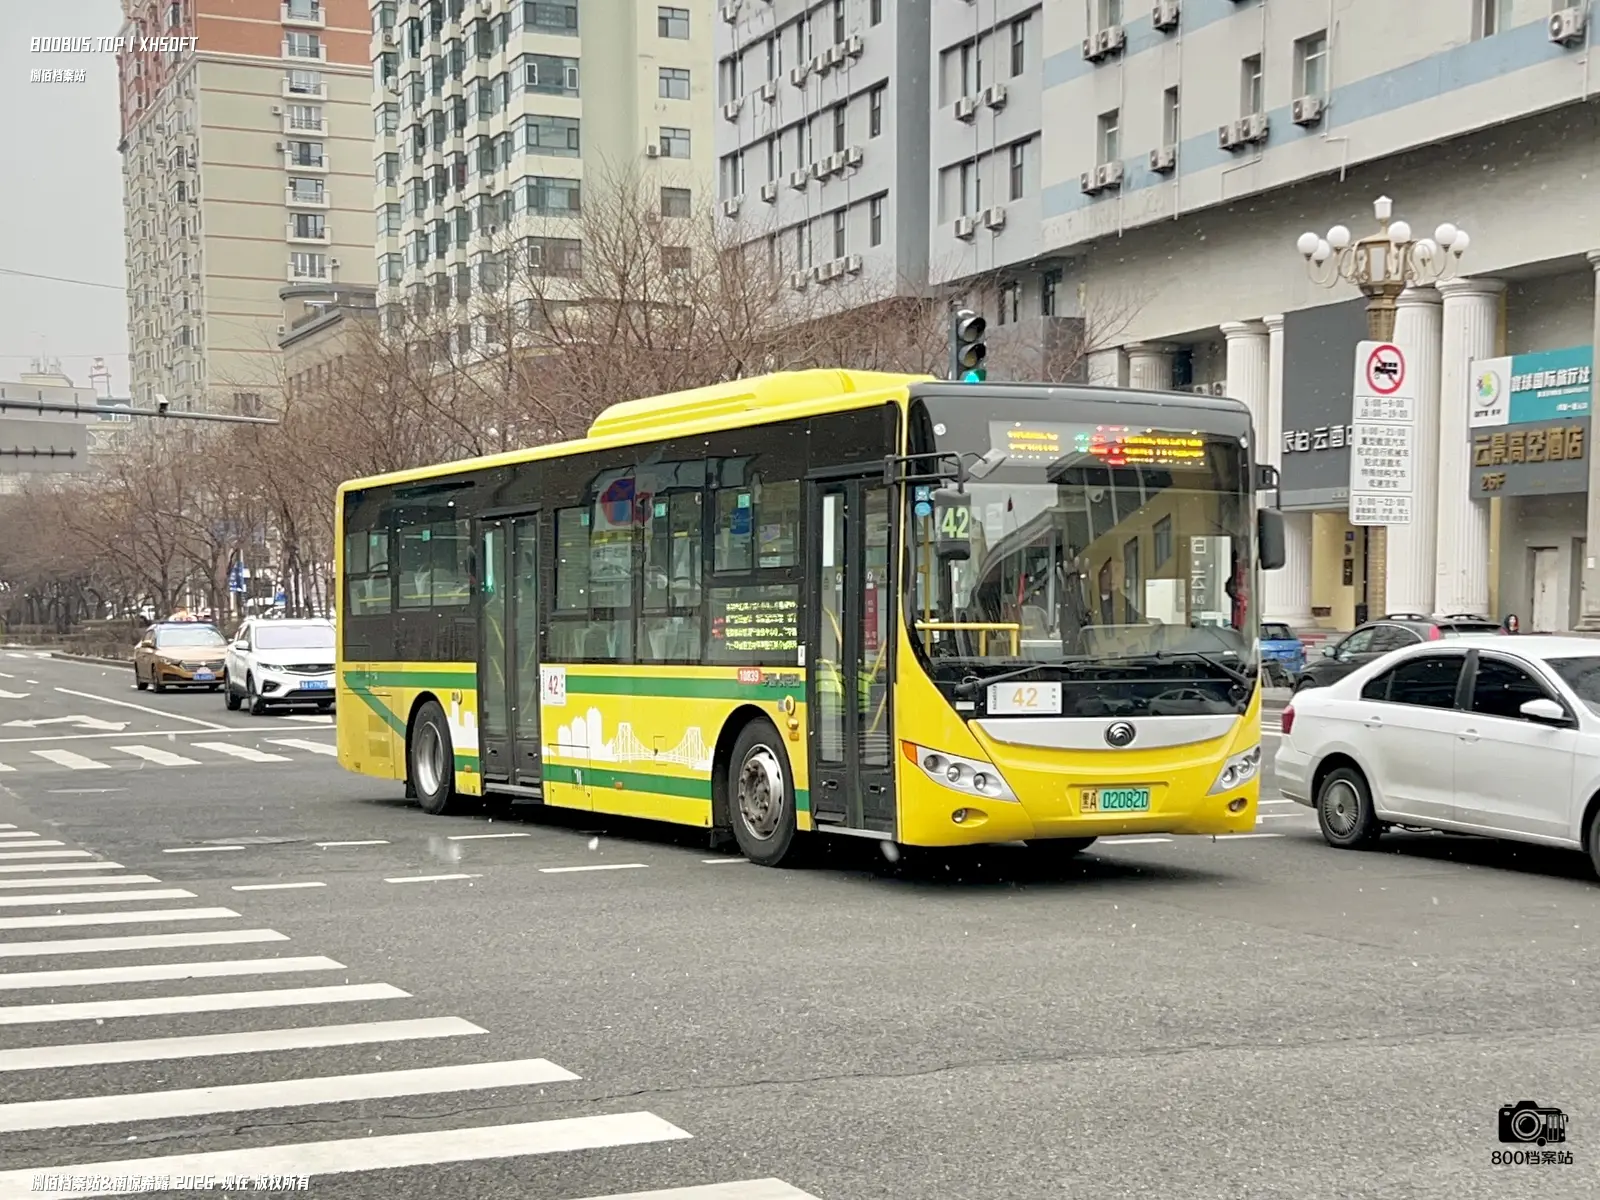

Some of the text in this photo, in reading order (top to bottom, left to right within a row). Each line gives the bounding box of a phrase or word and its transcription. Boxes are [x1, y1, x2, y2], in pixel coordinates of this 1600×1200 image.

[1474, 425, 1584, 467] 云景高空酒店
[941, 507, 969, 538] 42
[548, 675, 558, 695] 42
[1012, 687, 1038, 707] 42
